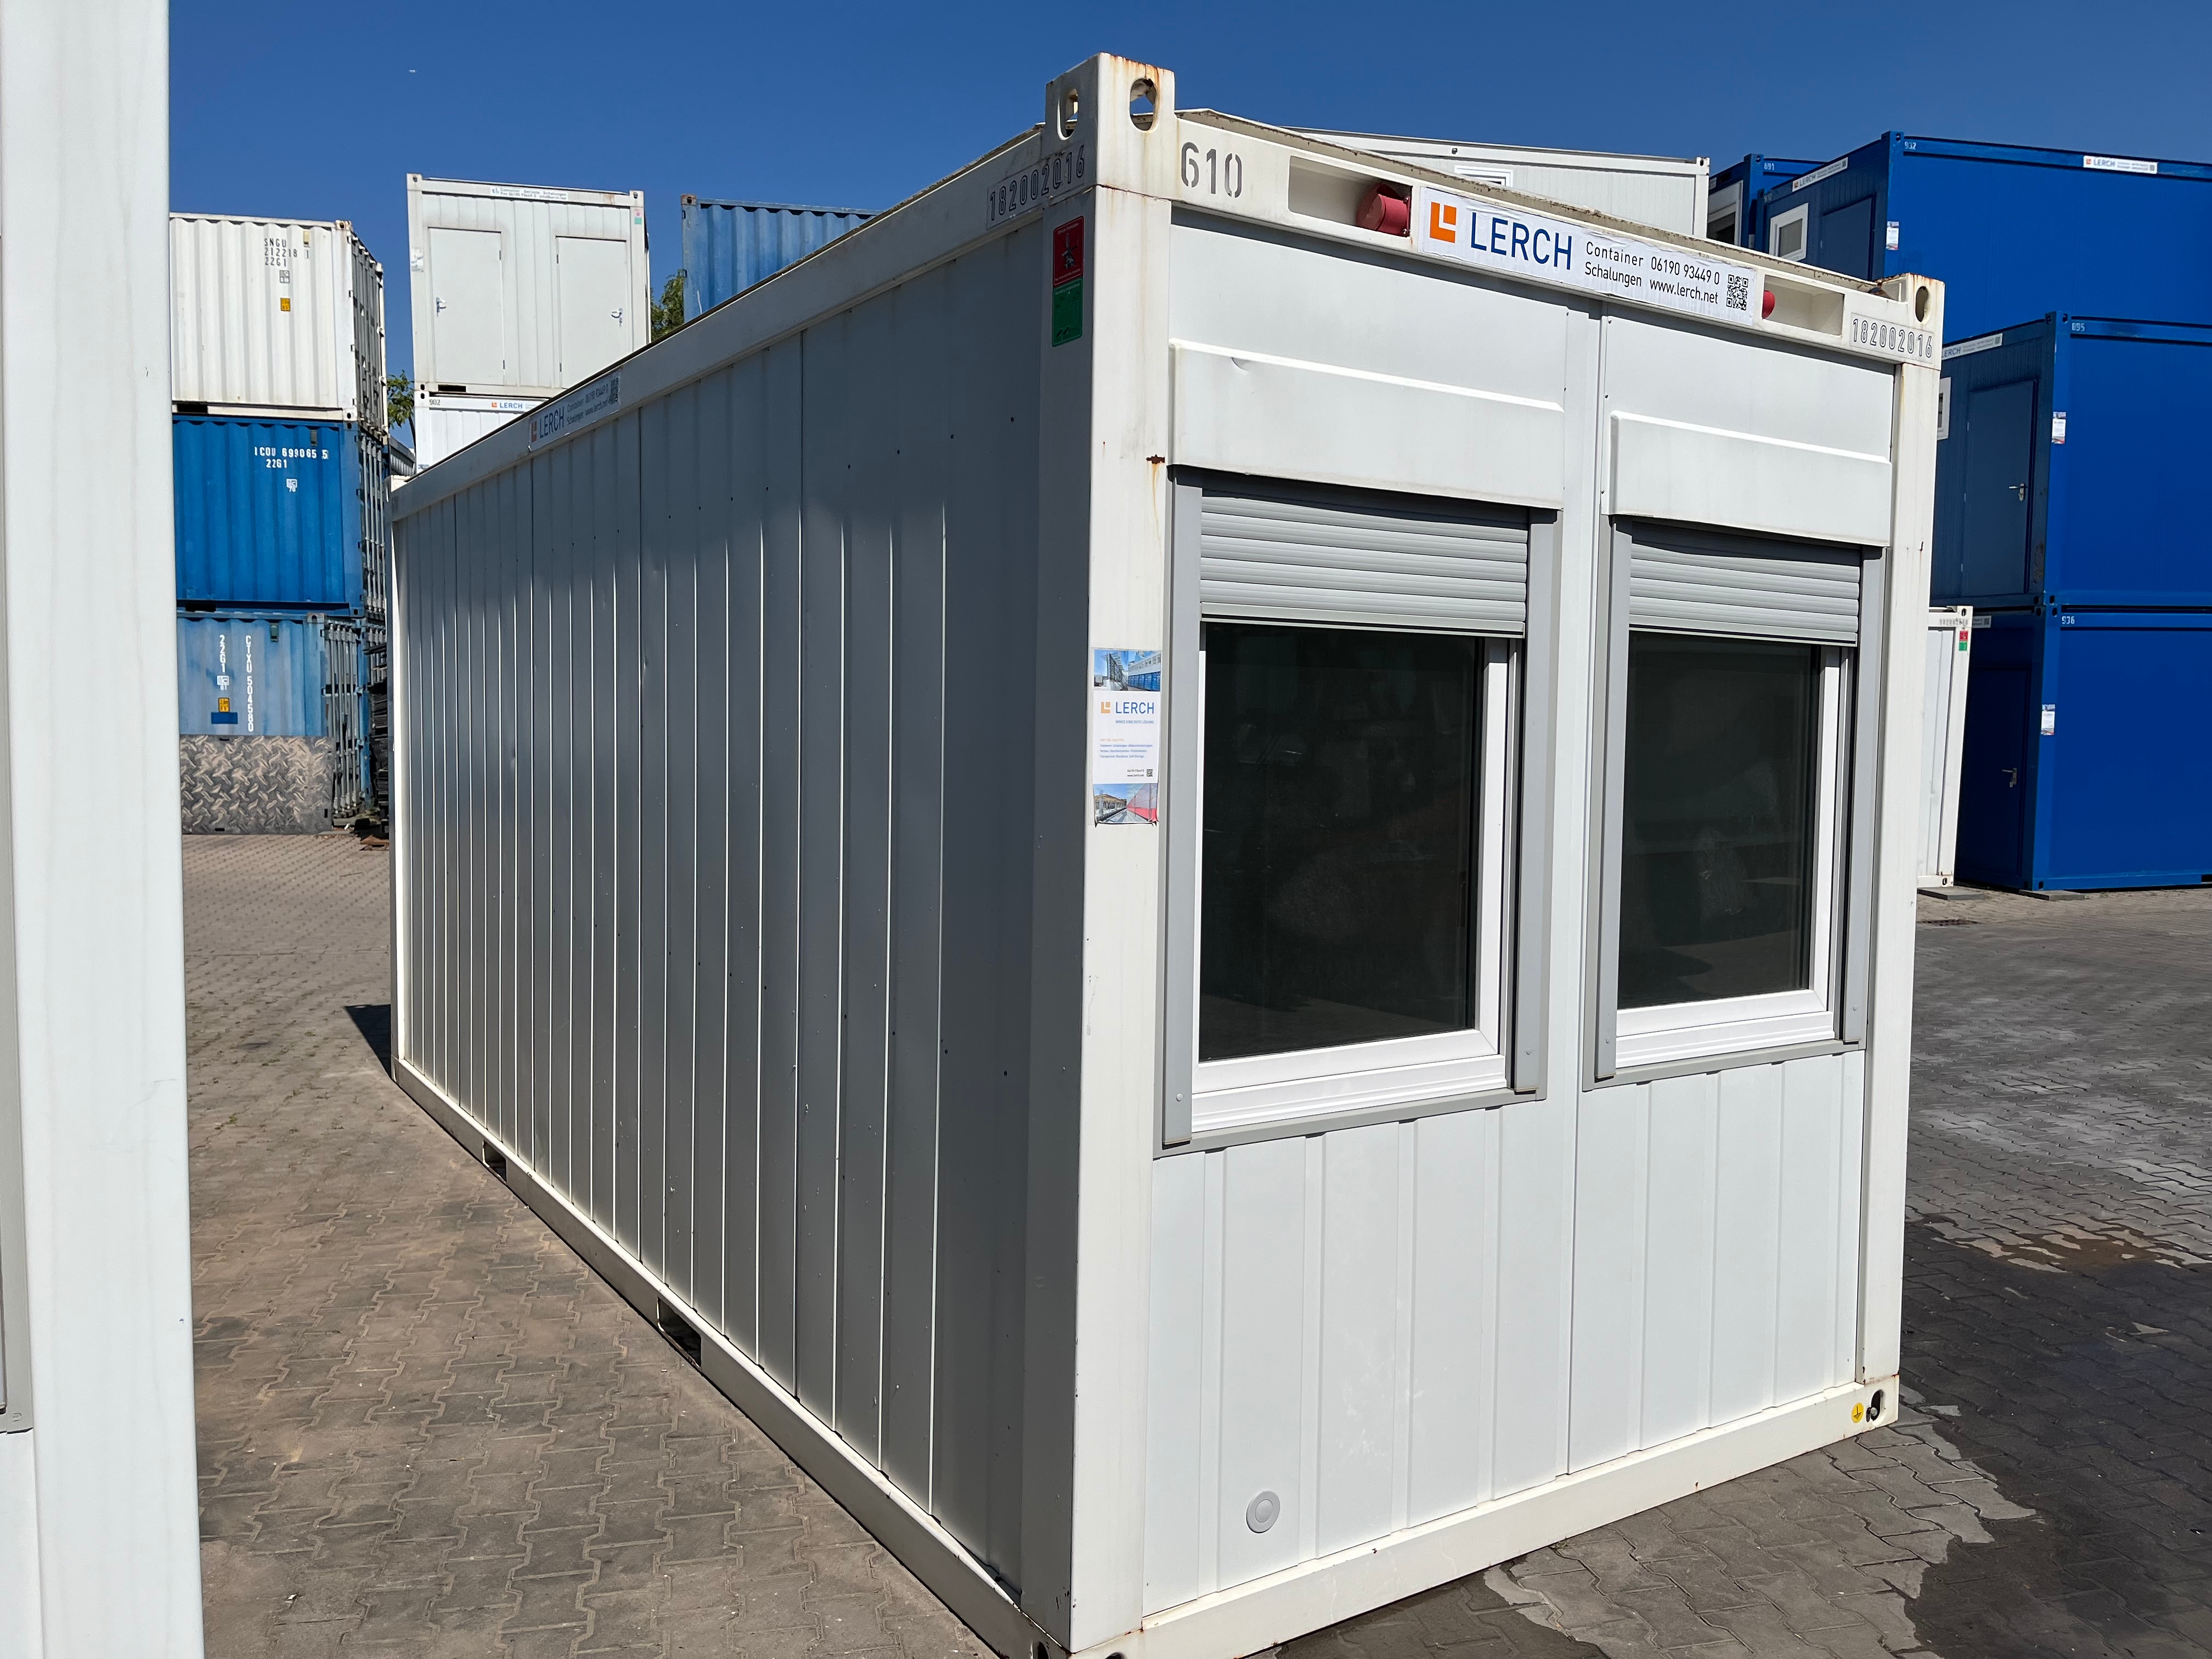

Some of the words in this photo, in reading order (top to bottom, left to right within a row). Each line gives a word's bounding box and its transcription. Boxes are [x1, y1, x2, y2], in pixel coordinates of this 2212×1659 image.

[1181, 142, 1243, 199] 610
[990, 144, 1085, 221] 182002016
[264, 238, 287, 248] SNGU
[1470, 211, 1572, 271] LERCH
[264, 247, 297, 257] 212218
[264, 257, 287, 267] 22G1
[1586, 241, 1644, 267] Container
[1651, 256, 1680, 275] 06190
[1684, 264, 1712, 283] 93449
[1714, 272, 1720, 285] 0
[1584, 261, 1642, 287] Schalungen
[1650, 279, 1718, 304] www.lerch.net
[1853, 318, 1933, 358] 182002016
[1942, 346, 1961, 358] ERCH
[539, 406, 565, 439] LERCH
[254, 446, 276, 456] ICOU
[281, 447, 317, 459] 699065
[322, 449, 328, 460] 5
[266, 459, 287, 469] 22G1
[2062, 616, 2075, 625] 936
[1115, 702, 1154, 714] LERCH
